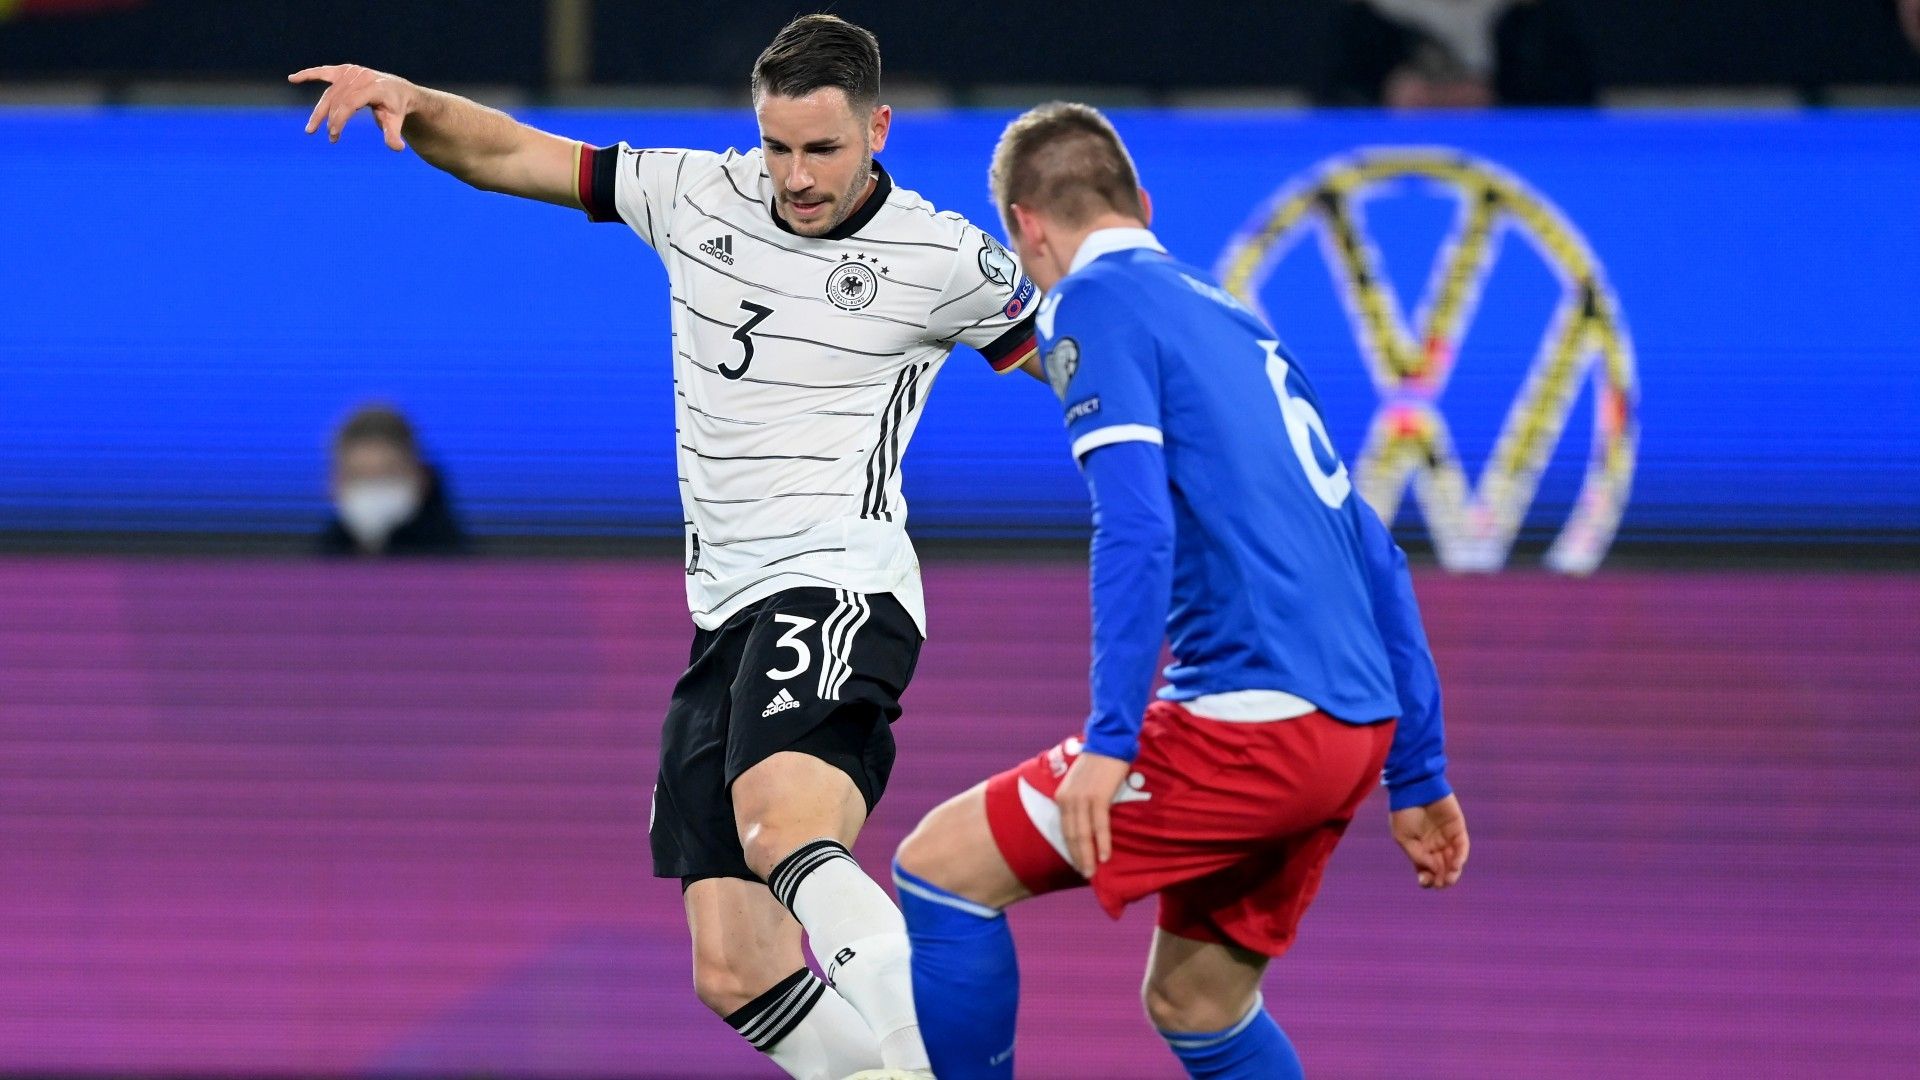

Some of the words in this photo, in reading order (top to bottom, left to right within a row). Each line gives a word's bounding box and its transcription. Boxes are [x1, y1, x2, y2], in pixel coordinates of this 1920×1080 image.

[699, 243, 735, 266] adidas
[717, 300, 774, 380] 3
[1256, 339, 1351, 509] 6
[766, 613, 816, 681] 3
[762, 700, 800, 718] adidas
